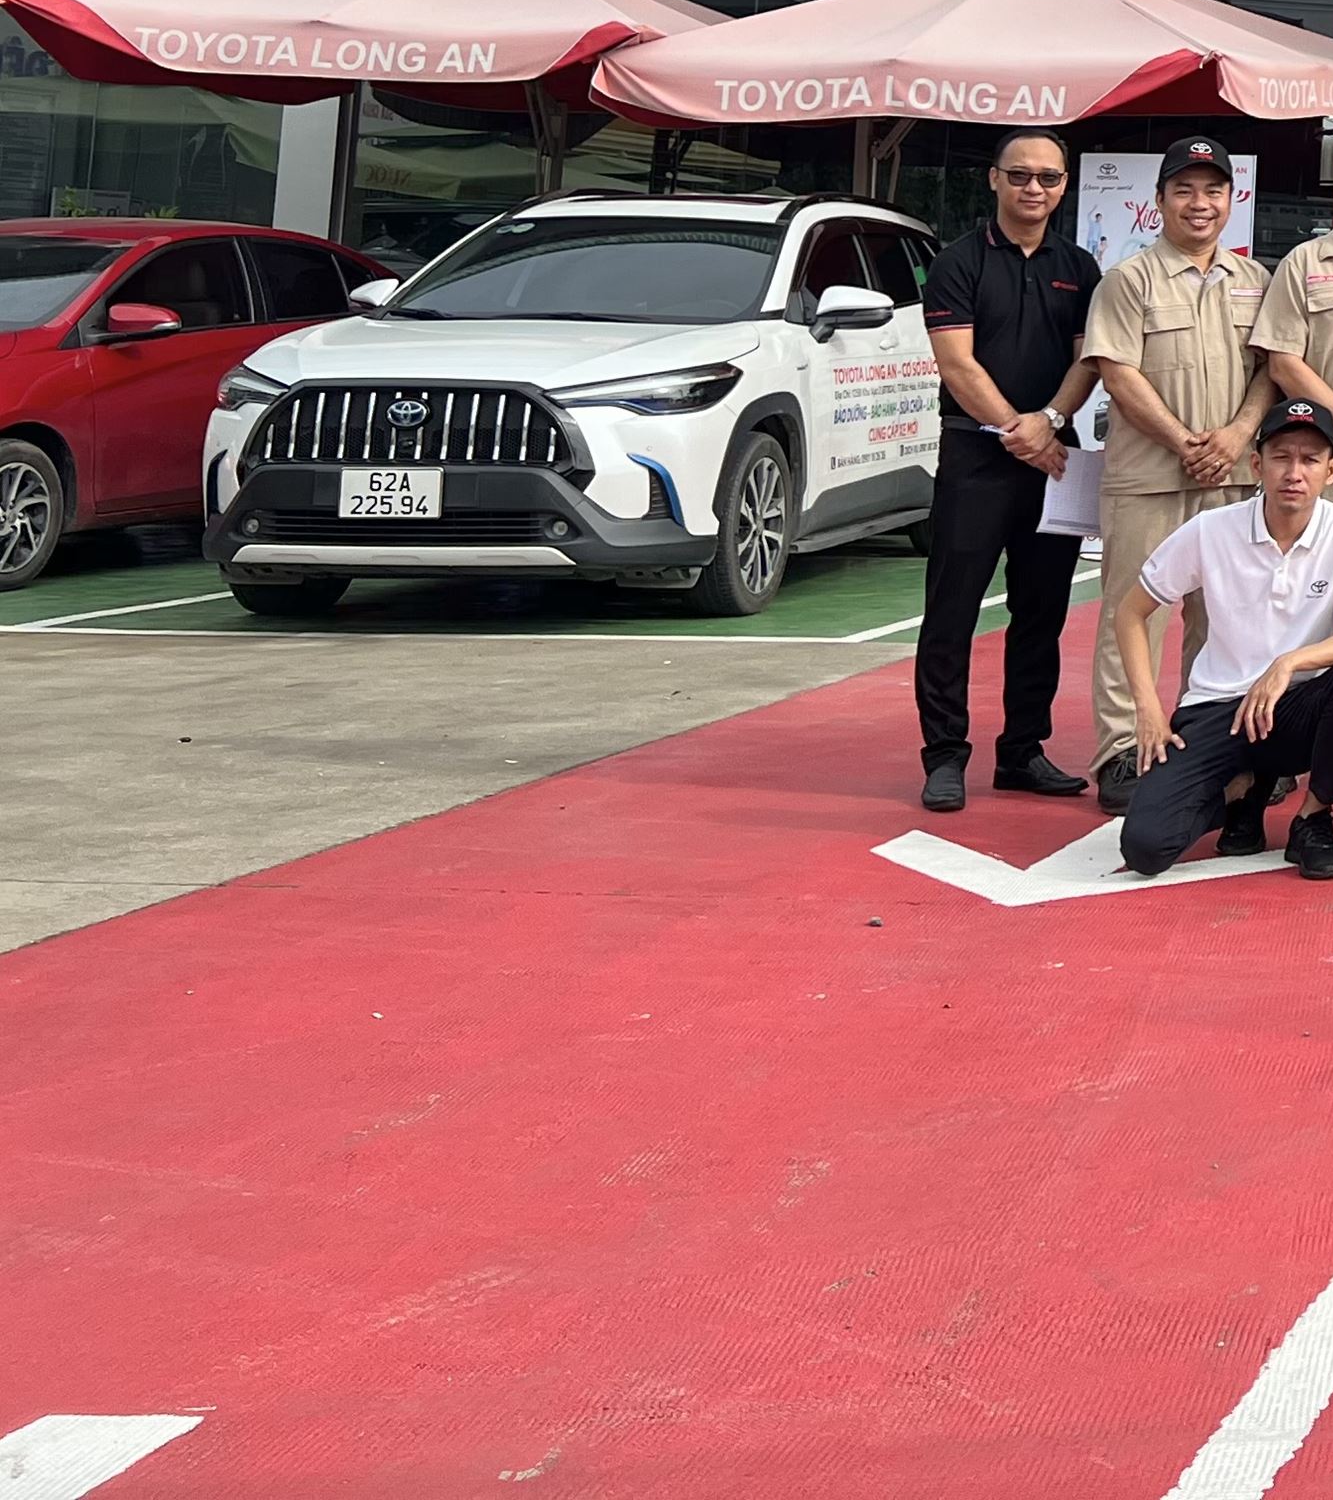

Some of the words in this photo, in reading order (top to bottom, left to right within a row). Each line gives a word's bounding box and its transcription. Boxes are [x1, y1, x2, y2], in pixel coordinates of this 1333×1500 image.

[134, 26, 298, 68] TOYOTA
[310, 37, 427, 73] LONG
[435, 41, 496, 74] AN
[714, 76, 873, 111] TOYOTA
[884, 75, 998, 115] LONG
[1007, 84, 1067, 117] AN
[1258, 77, 1318, 109] TOYOTA
[833, 365, 864, 385] TOYOTA
[865, 363, 886, 382] LONG
[887, 363, 897, 379] AN
[369, 472, 411, 492] 62A
[350, 495, 428, 515] 225.94
